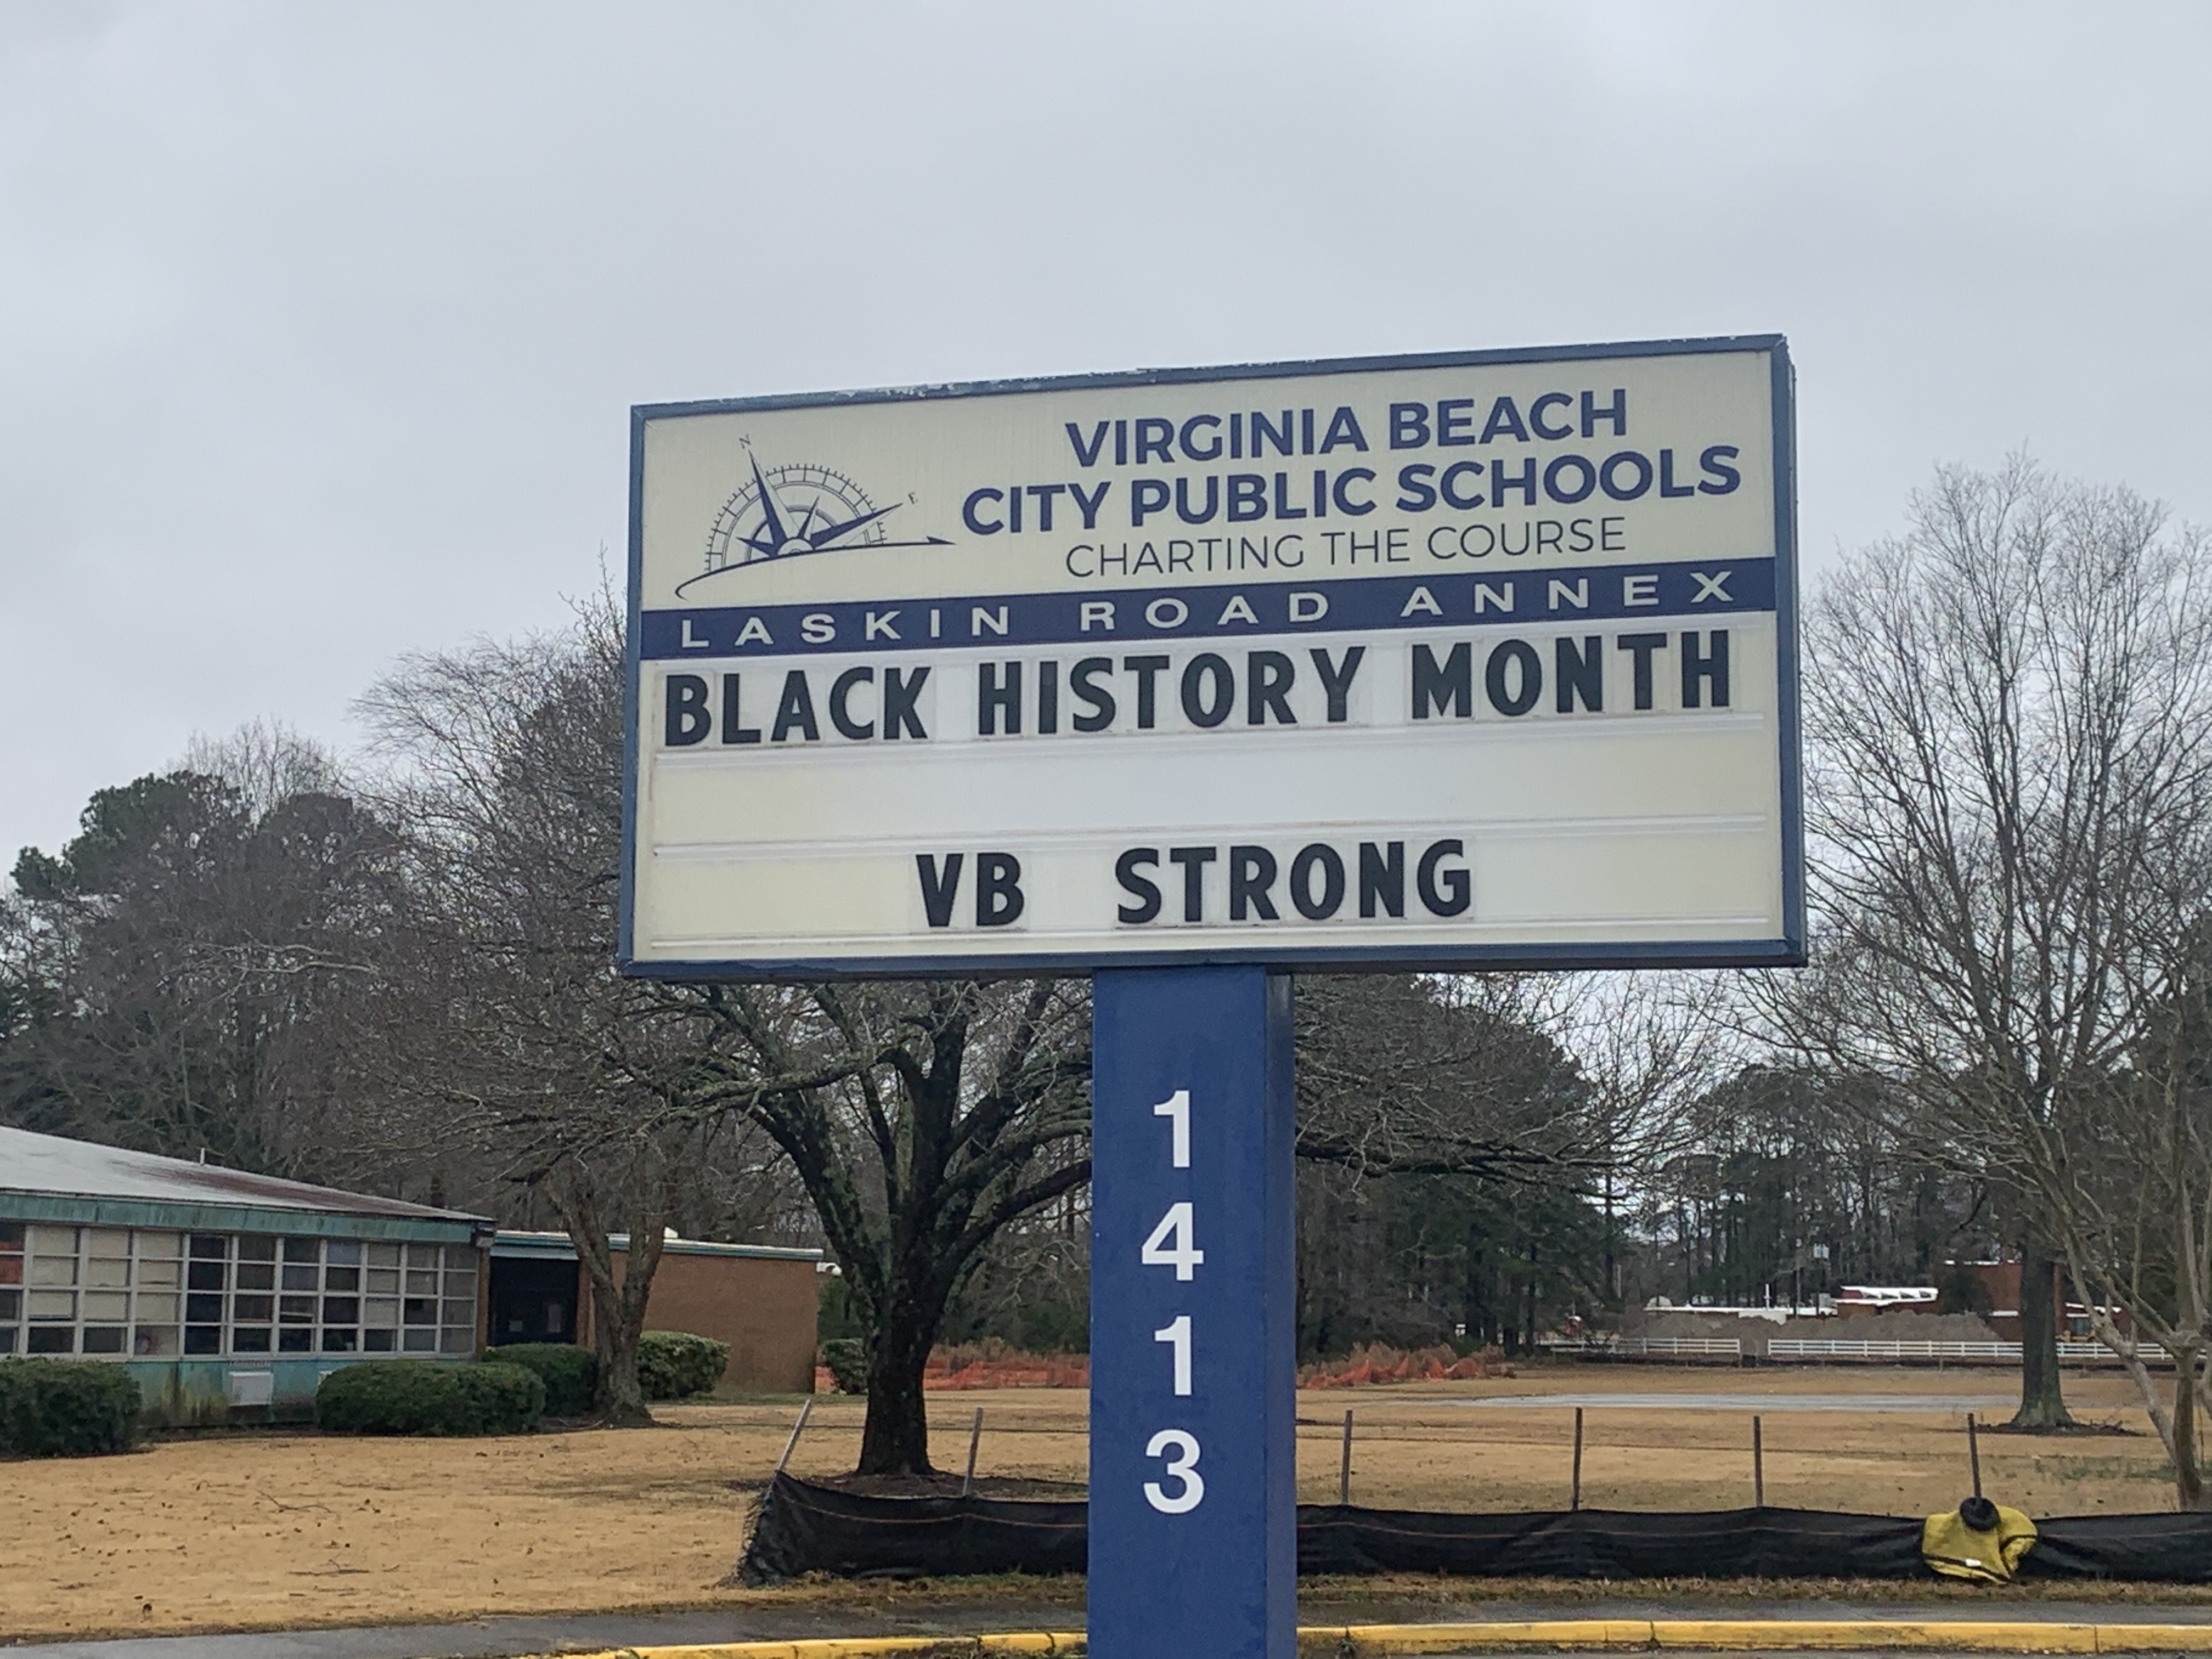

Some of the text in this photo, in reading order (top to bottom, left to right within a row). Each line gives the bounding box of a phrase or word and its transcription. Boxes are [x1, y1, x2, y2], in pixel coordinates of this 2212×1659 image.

[1065, 388, 1627, 467] VIRGINIA BEACH
[962, 445, 1741, 535] CITY PUBLIC SCHOOLS
[1066, 516, 1626, 578] CHARTING THE COURSE
[681, 571, 1734, 648] LASKIN ROAD ANNEX
[665, 629, 1730, 747] BLACK HISTORY MONTH
[915, 839, 1471, 928] VB STRONG
